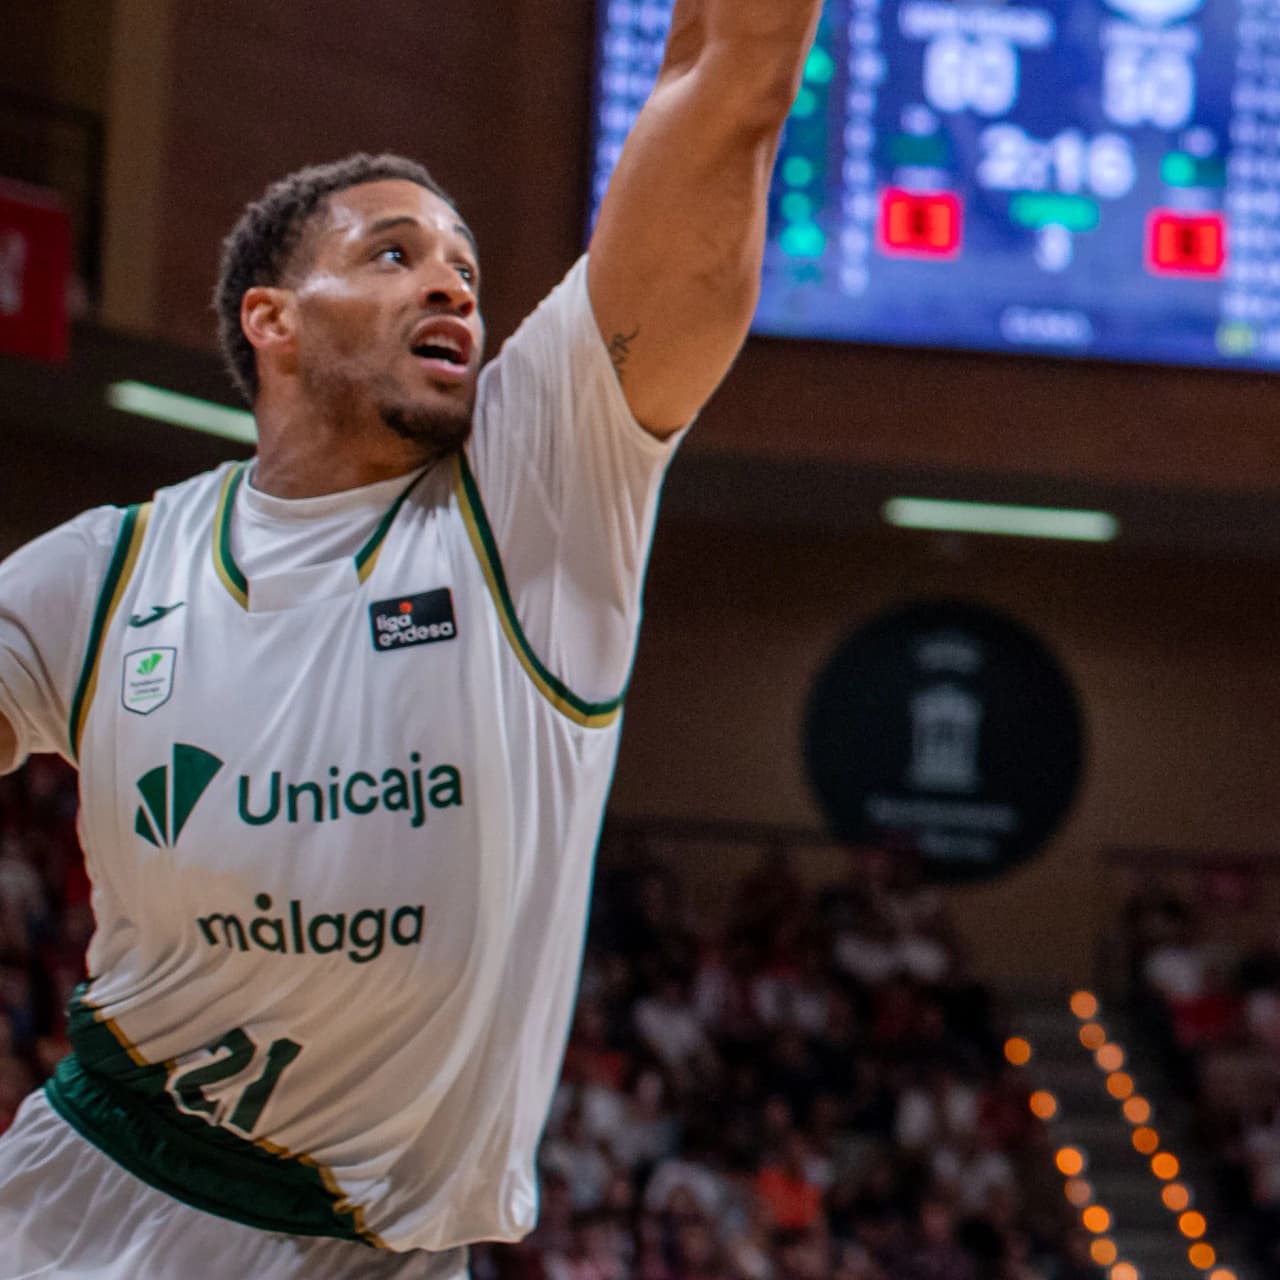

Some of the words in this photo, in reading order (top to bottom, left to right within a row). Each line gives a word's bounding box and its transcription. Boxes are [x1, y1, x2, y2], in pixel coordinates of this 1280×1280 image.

[376, 613, 411, 632] liga
[379, 621, 454, 647] endesa
[237, 751, 464, 829] Unicaja
[168, 1026, 303, 1134] 21
